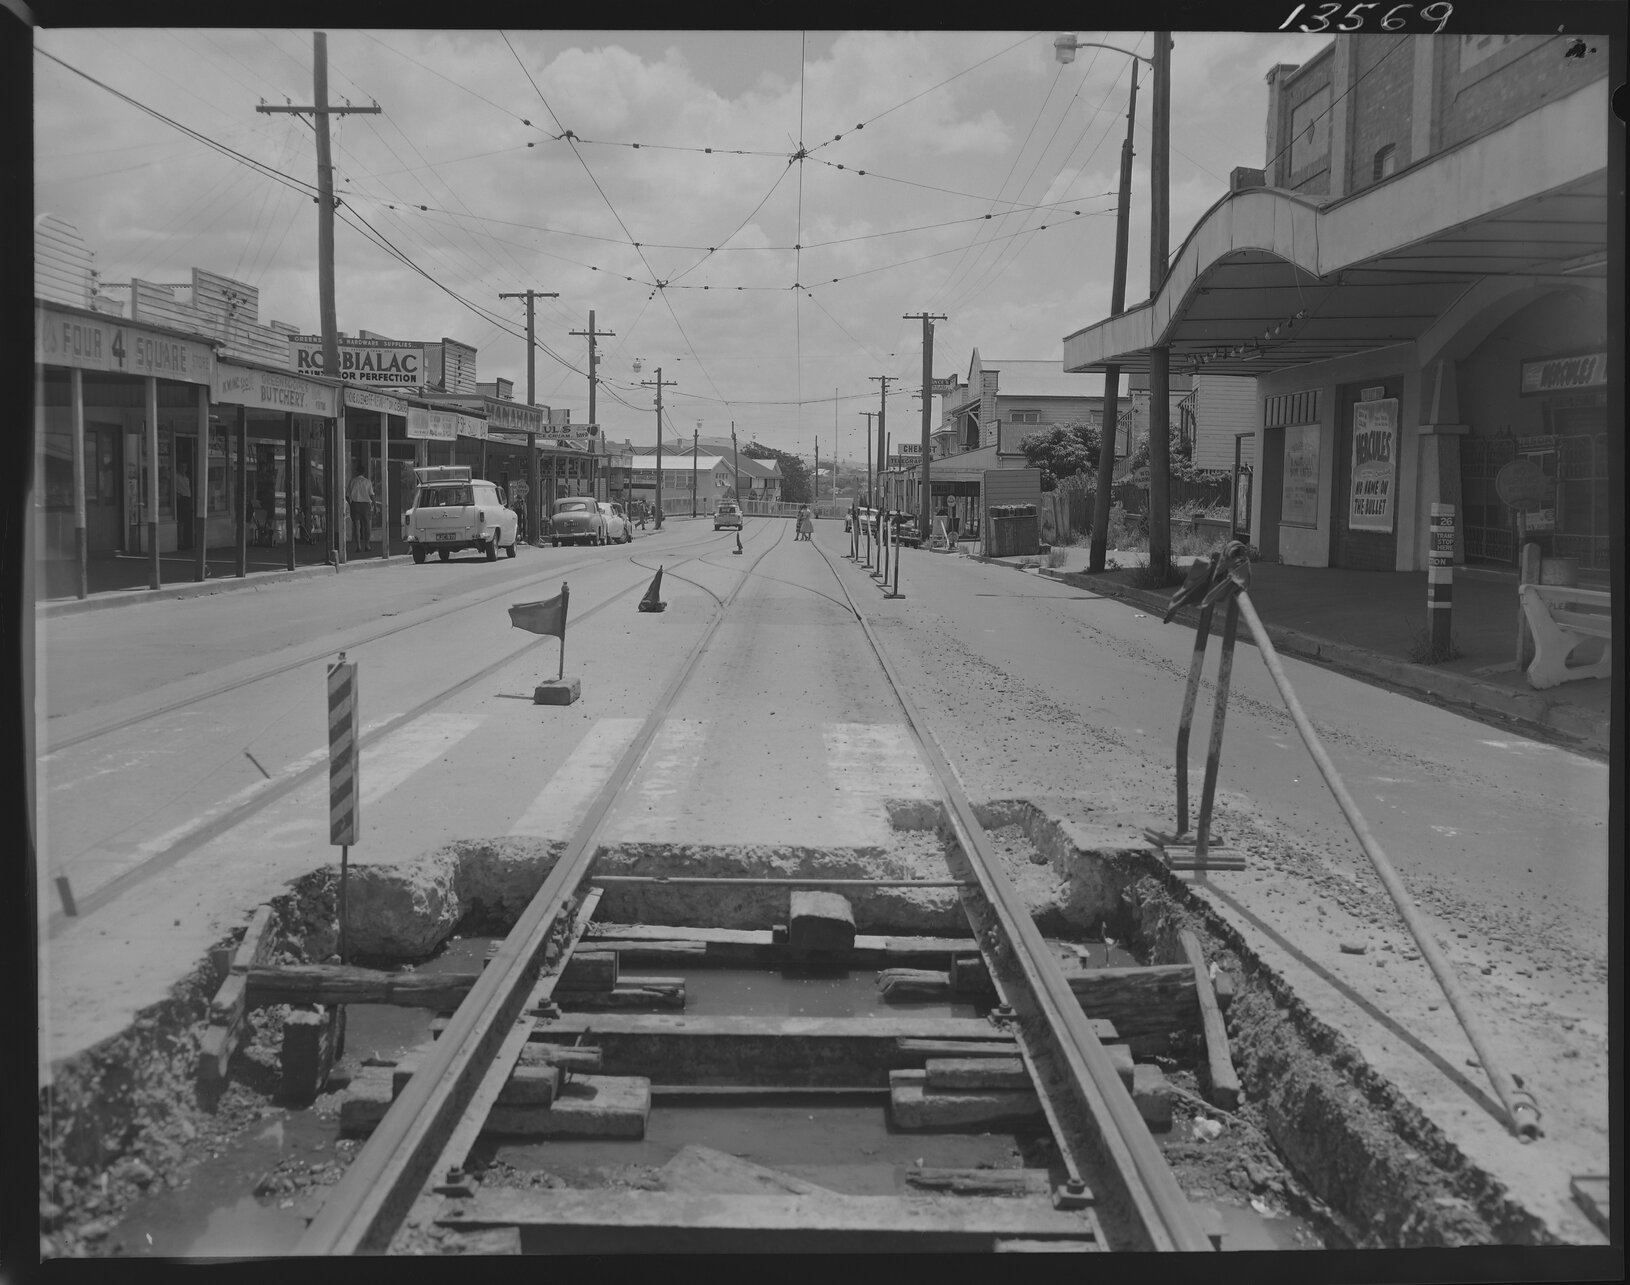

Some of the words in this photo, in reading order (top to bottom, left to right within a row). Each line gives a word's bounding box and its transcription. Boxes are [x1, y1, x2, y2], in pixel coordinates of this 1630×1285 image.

[1278, 2, 1453, 34] 13569
[63, 322, 102, 359] FOUR
[112, 329, 126, 368] 4
[136, 336, 187, 373] SQUARE
[346, 338, 379, 347] HARDWARE
[298, 349, 418, 373] ROBIALAC
[359, 373, 417, 383] PERFECTION
[1540, 357, 1598, 388] HERCULES
[1356, 430, 1392, 467] HERCULES
[1355, 480, 1364, 496] NO
[1363, 479, 1380, 496] NAME
[1380, 479, 1390, 496] ON
[1353, 498, 1365, 515] THE
[1364, 498, 1387, 515] BULLET
[1440, 517, 1453, 526] 26
